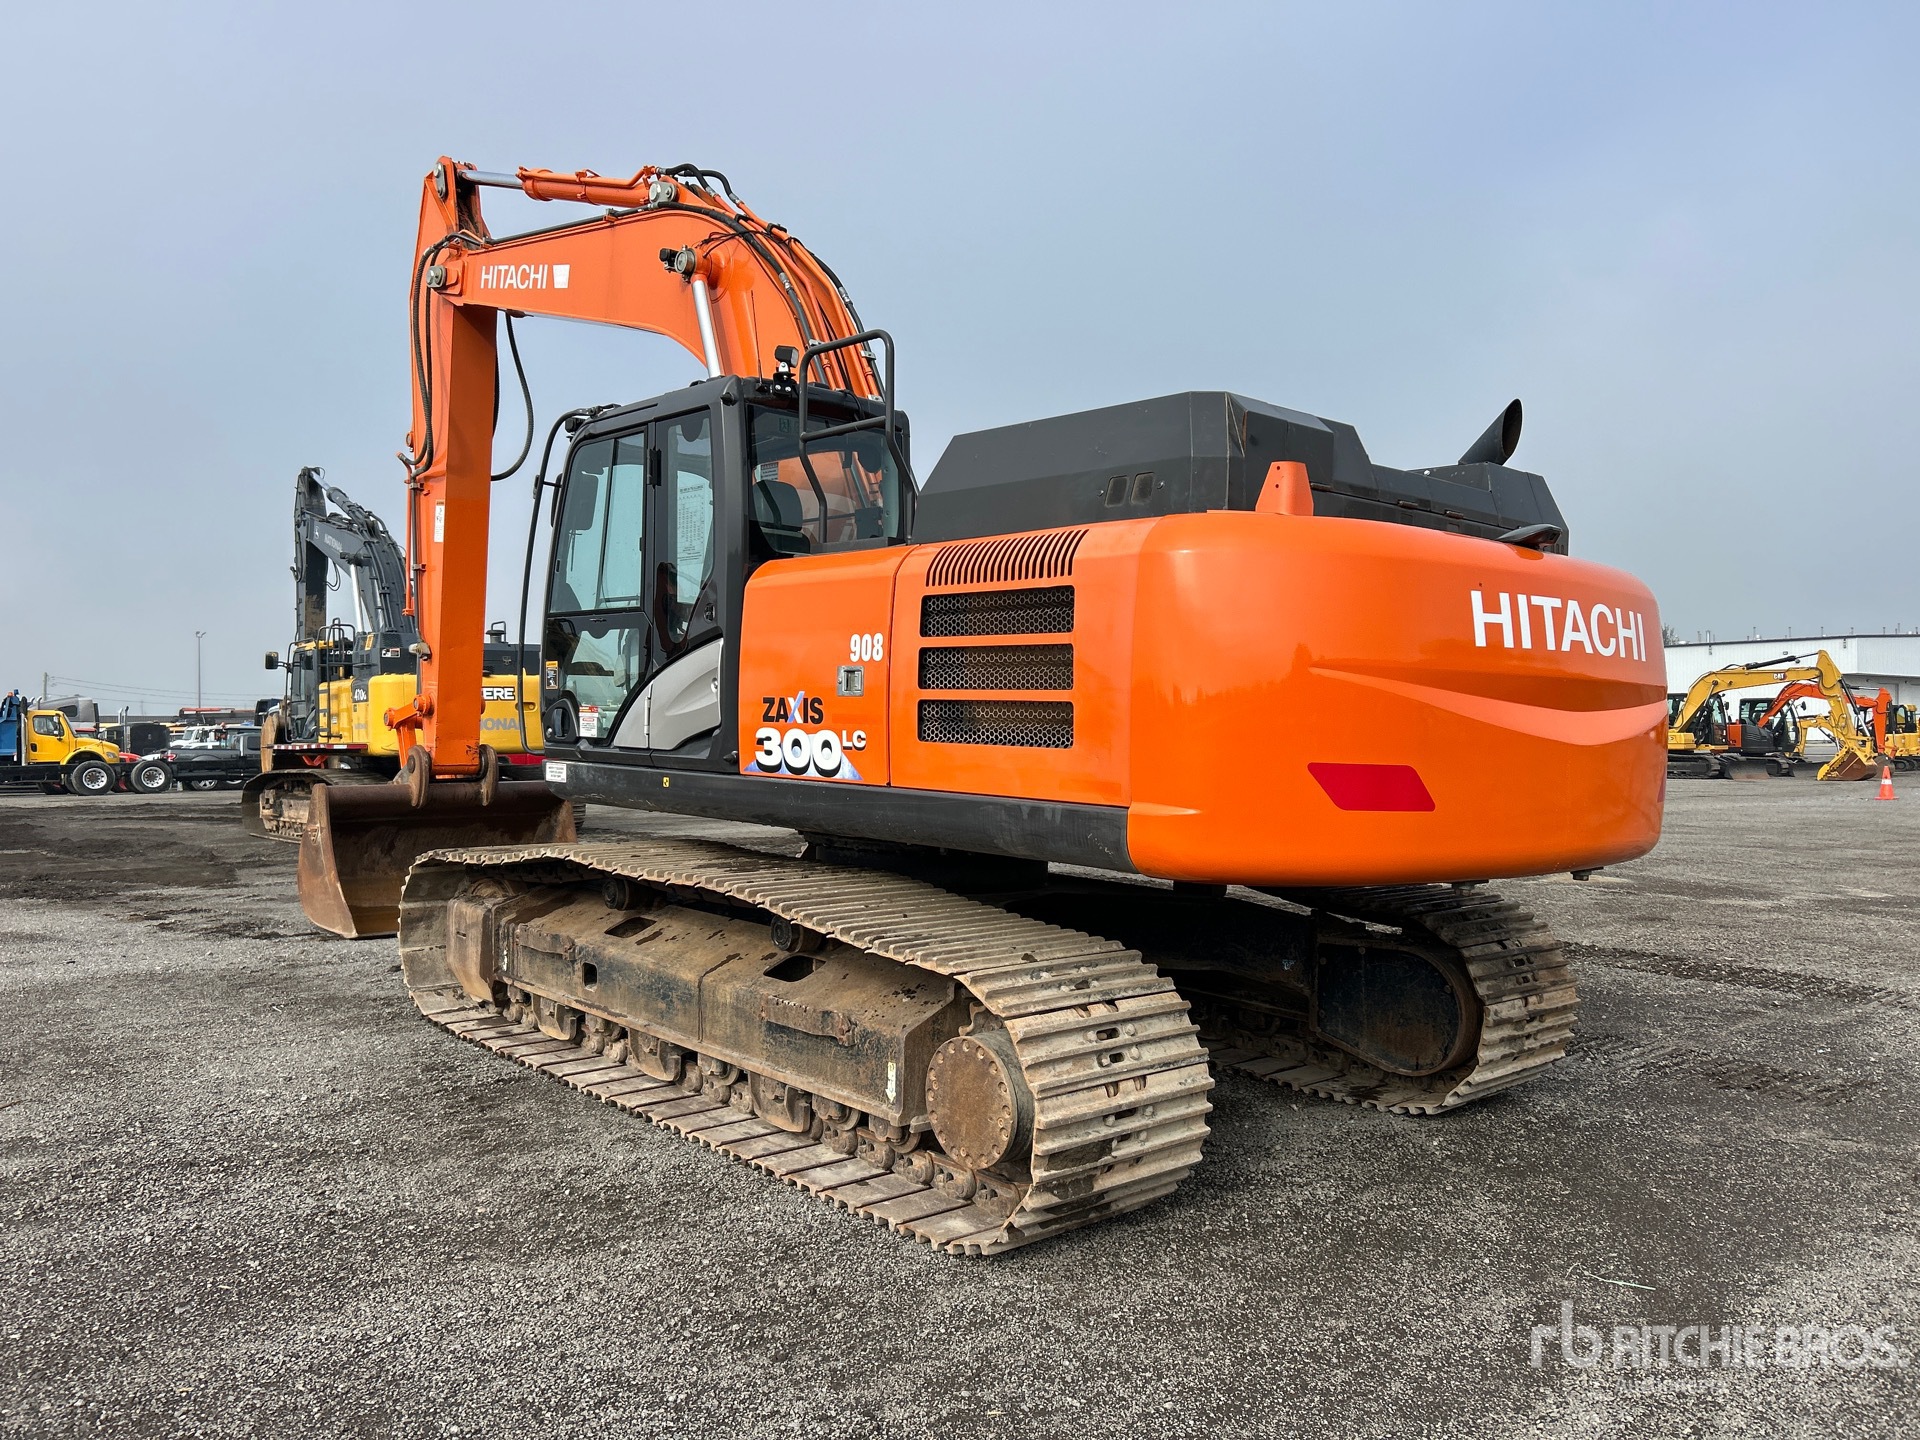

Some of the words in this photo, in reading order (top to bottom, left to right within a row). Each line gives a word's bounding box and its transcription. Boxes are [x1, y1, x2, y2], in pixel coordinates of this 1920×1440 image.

[480, 264, 548, 289] HITACHI
[1470, 590, 1646, 662] HITACHI
[850, 633, 883, 662] 908
[1773, 672, 1785, 680] CAT
[481, 687, 514, 700] ERE
[762, 691, 824, 725] ZAXIS
[755, 727, 842, 777] 300
[842, 730, 867, 750] LC
